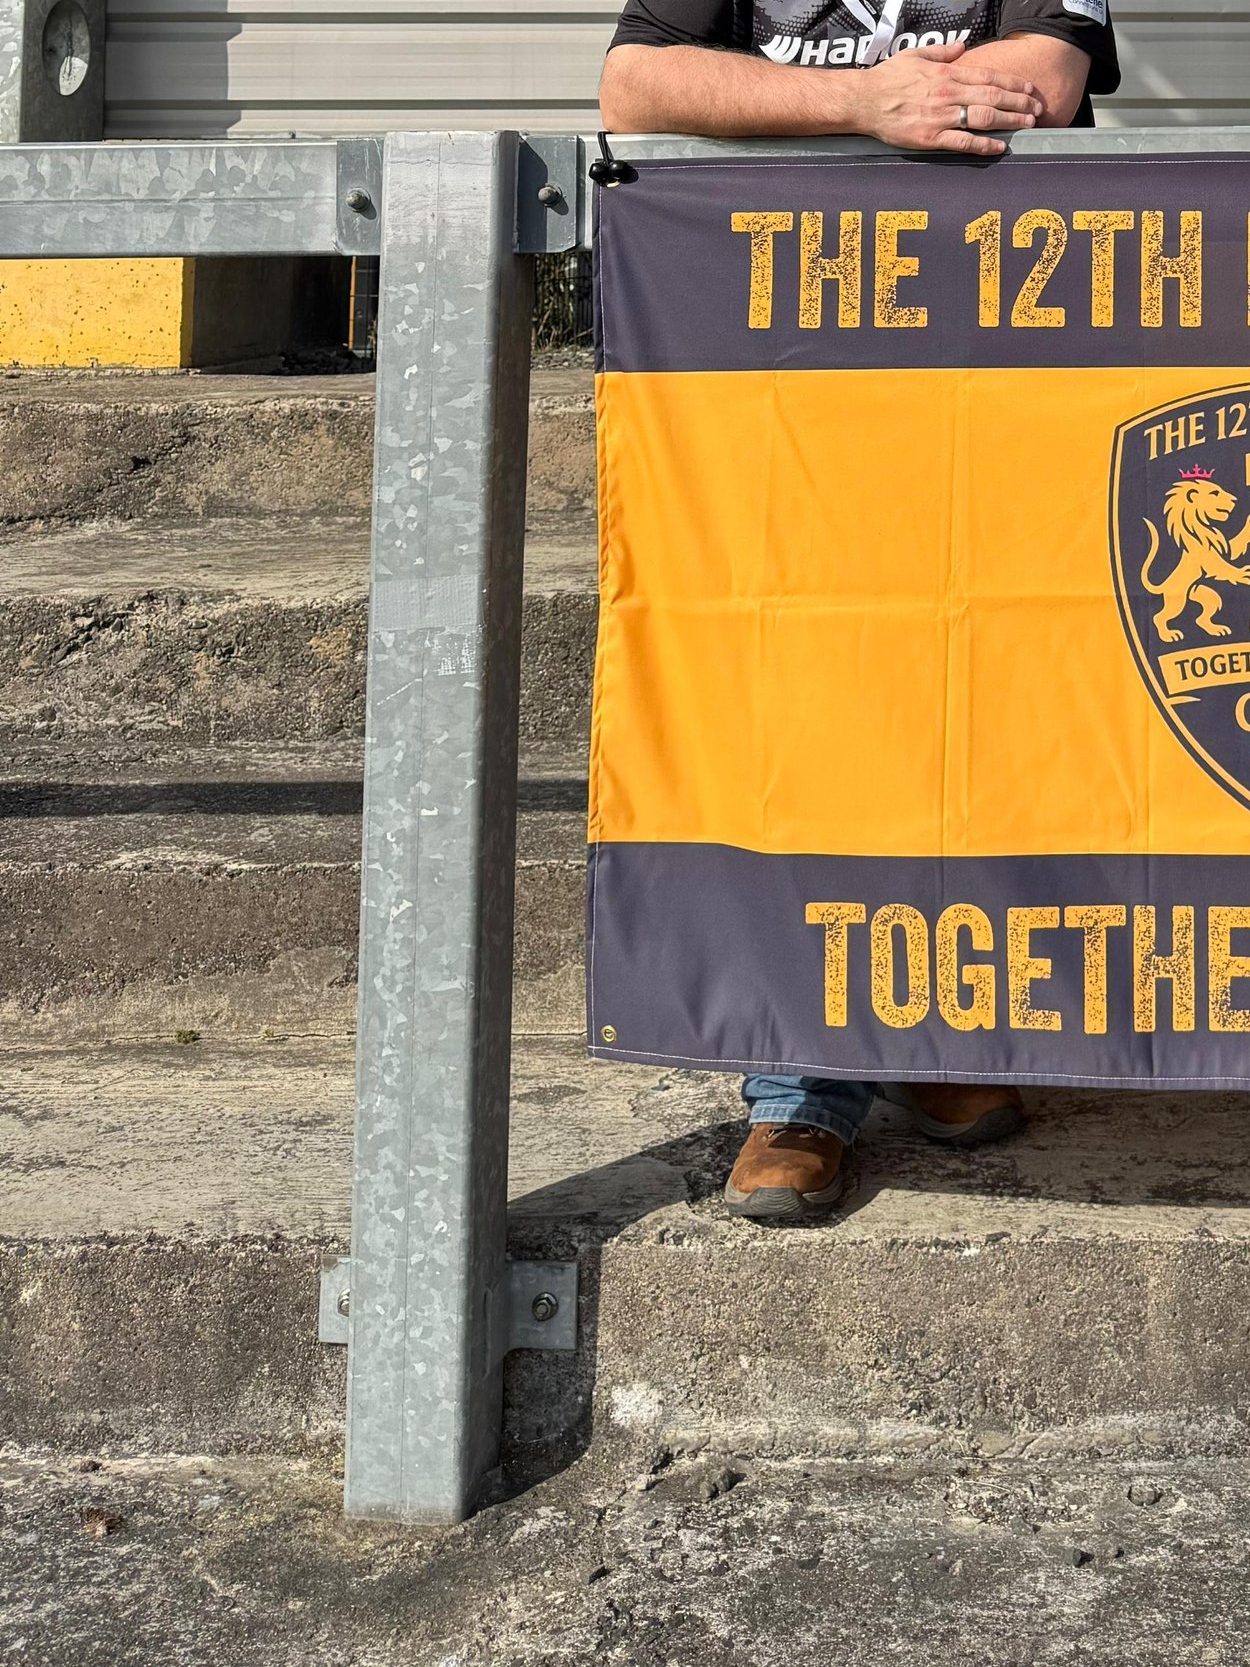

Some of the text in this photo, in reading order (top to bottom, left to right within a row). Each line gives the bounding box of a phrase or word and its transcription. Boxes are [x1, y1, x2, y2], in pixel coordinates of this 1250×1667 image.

[731, 210, 928, 329] THE
[965, 209, 1202, 328] 12TH
[1144, 411, 1206, 461] THE
